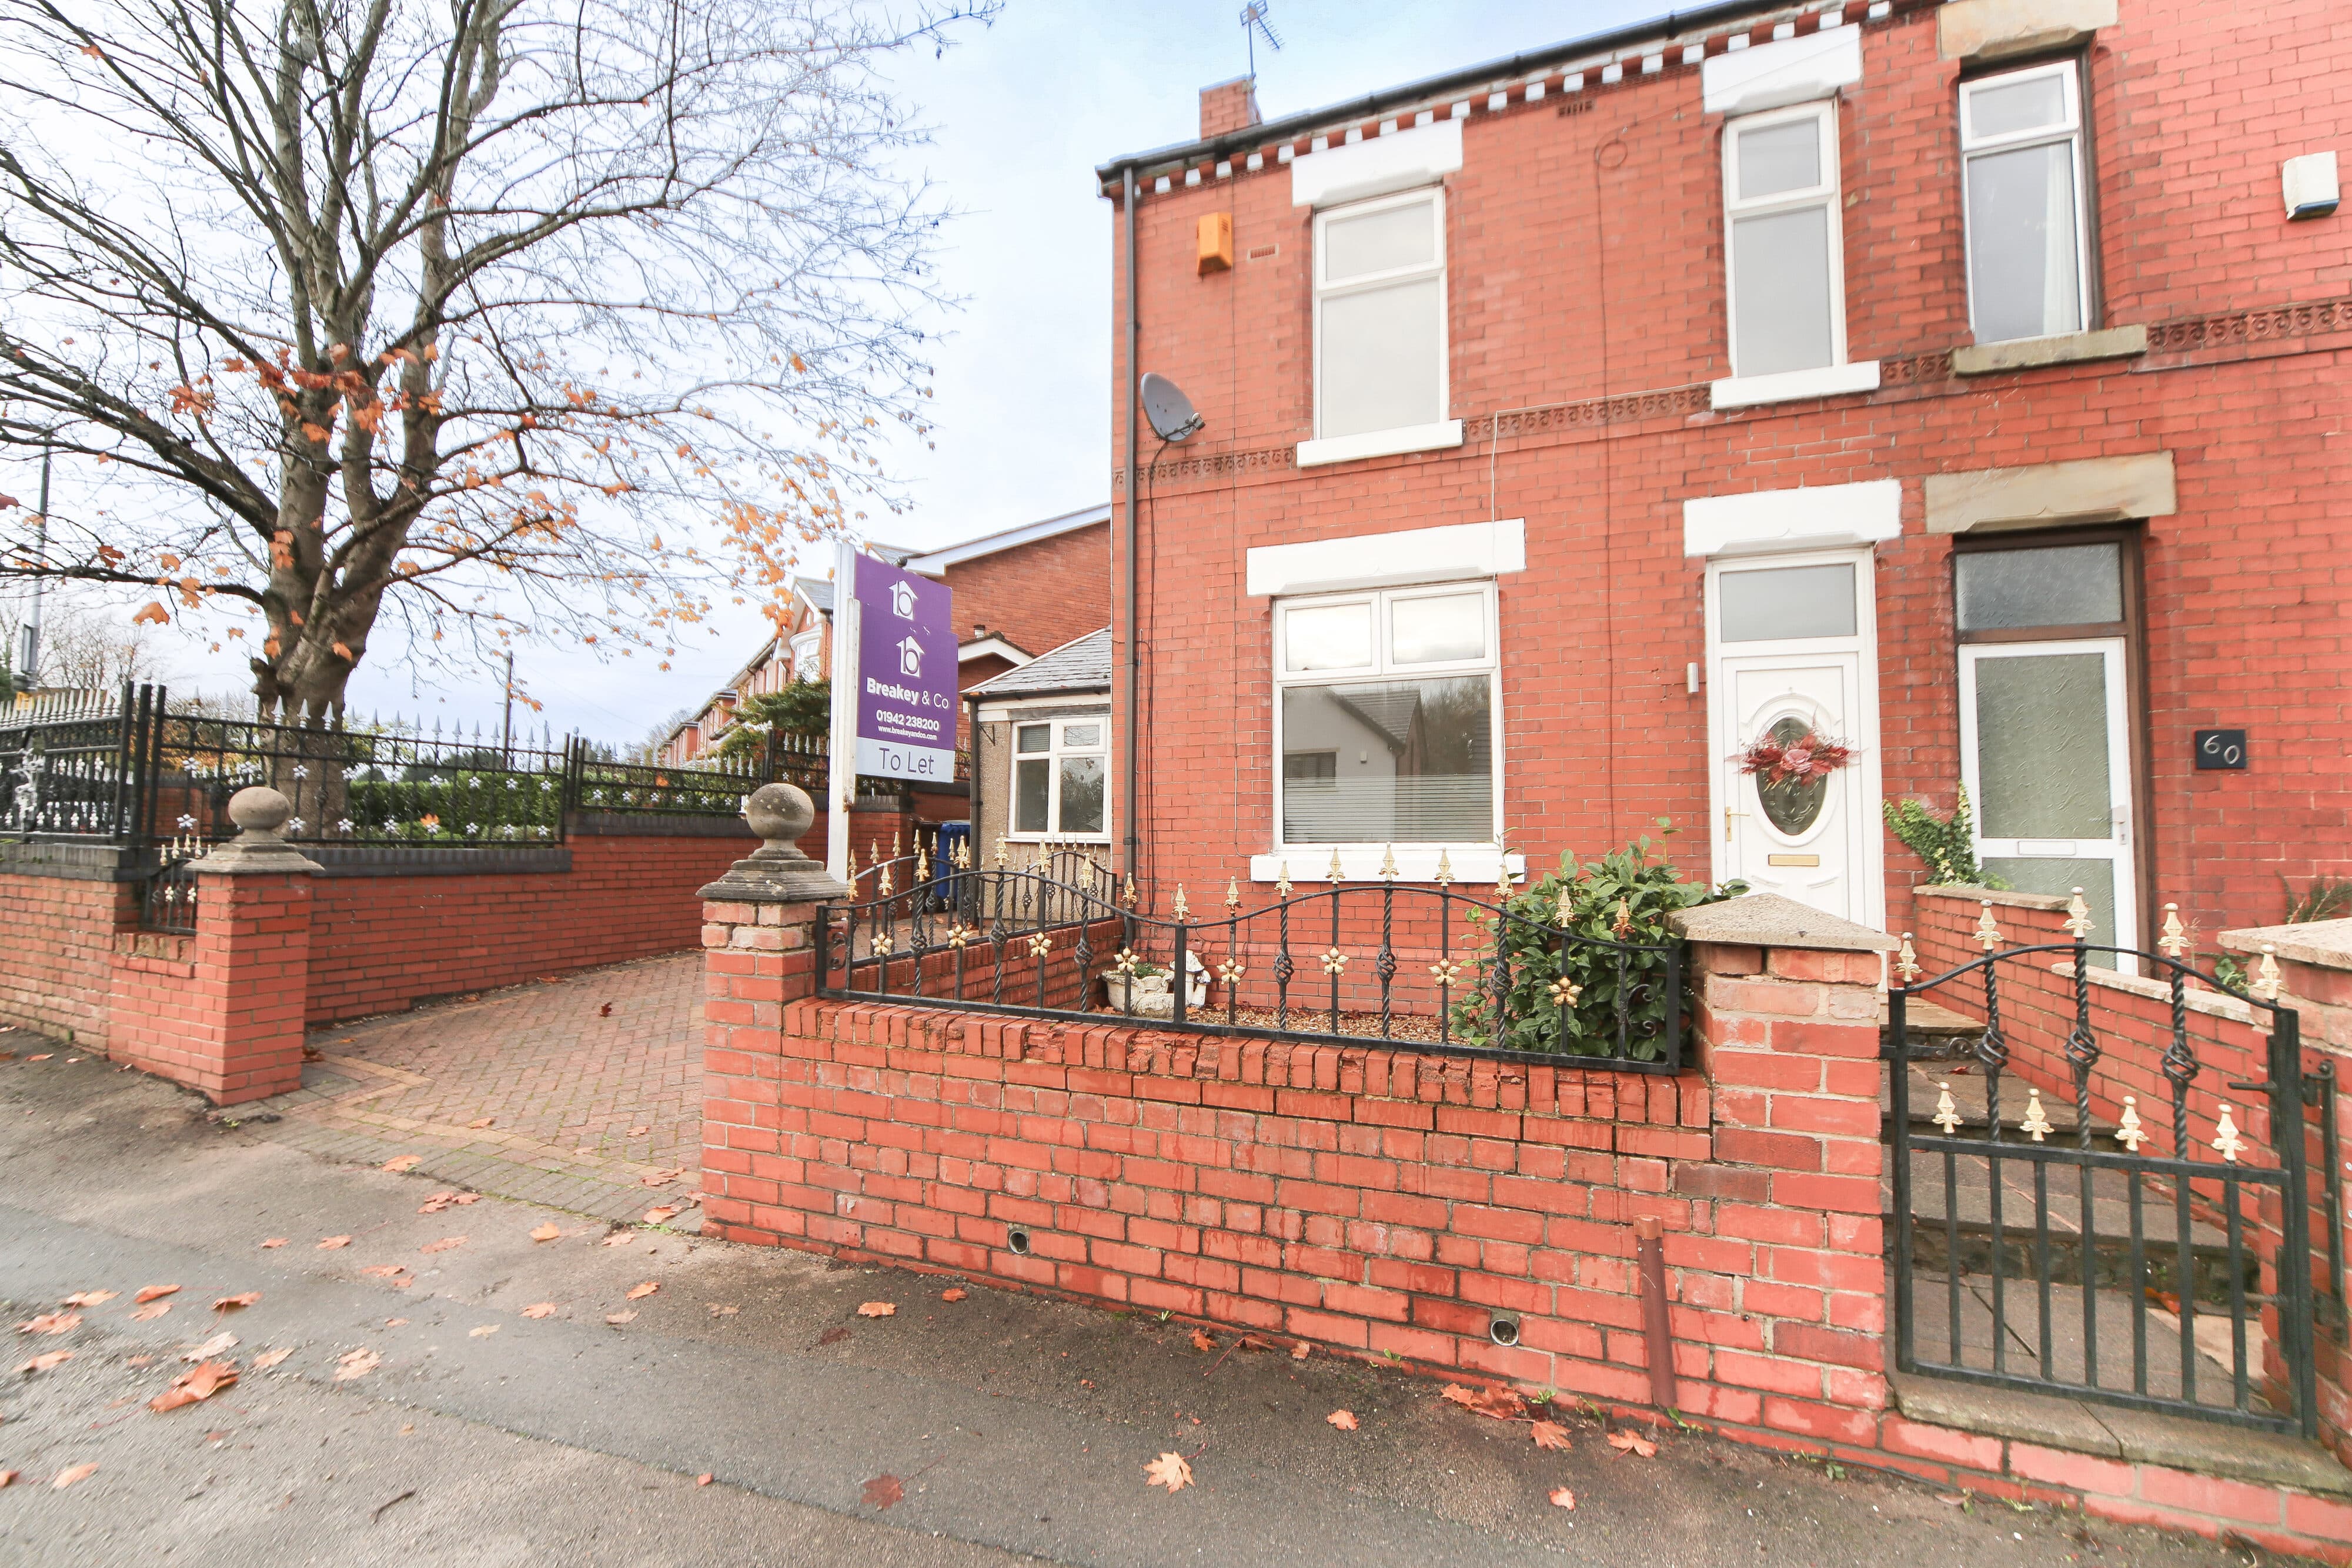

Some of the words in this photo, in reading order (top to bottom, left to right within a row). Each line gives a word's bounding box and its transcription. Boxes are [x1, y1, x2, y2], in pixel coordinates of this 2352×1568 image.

[866, 677, 919, 706] Breakey
[921, 690, 930, 706] &
[933, 693, 949, 709] Co
[876, 709, 904, 726] 01942
[906, 715, 940, 731] 238200
[878, 725, 937, 741] www.breakeyandco.com
[878, 747, 901, 771] To
[907, 751, 934, 775] Let
[2203, 734, 2241, 764] 60
